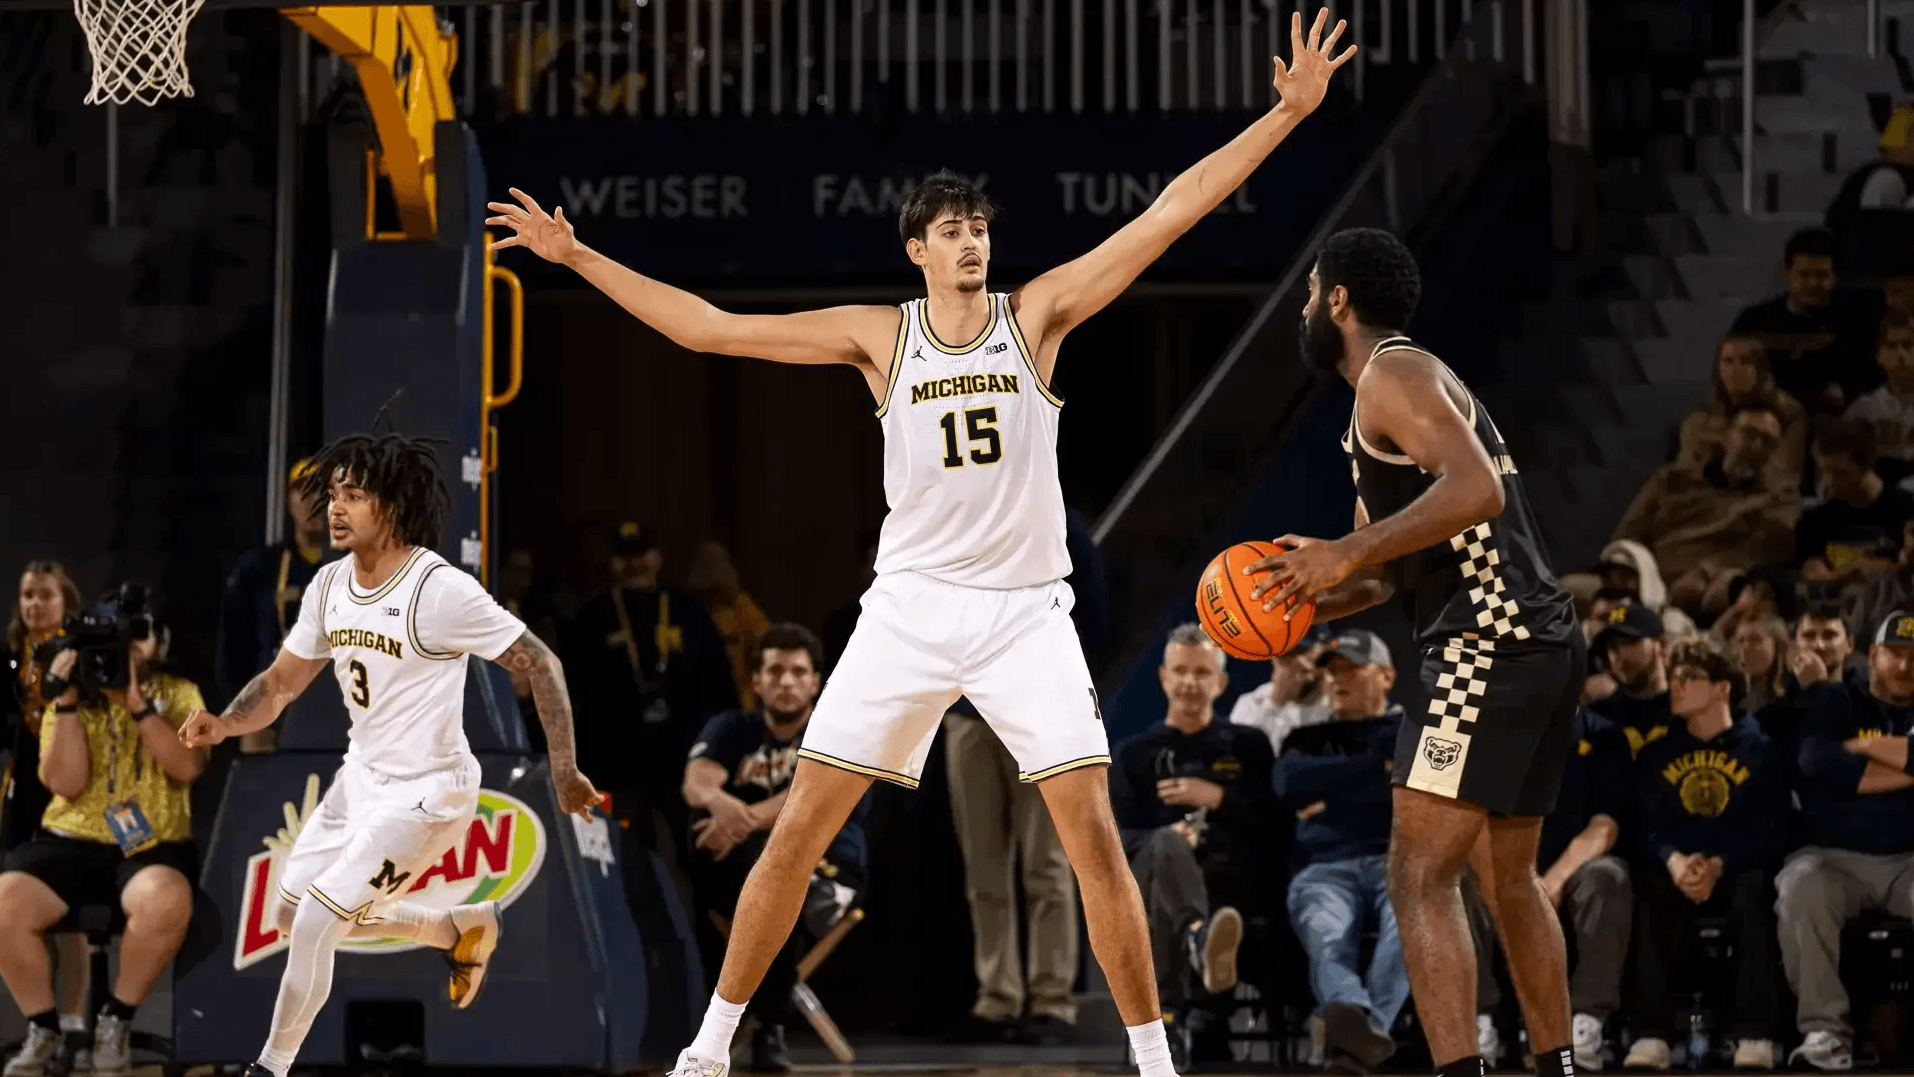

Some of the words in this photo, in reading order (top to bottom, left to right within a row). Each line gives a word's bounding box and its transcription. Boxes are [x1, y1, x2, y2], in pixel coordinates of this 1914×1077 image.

[559, 174, 748, 219] WEISER
[1054, 171, 1258, 216] TUNL
[910, 374, 1020, 405] MICHIGAN
[939, 405, 1002, 469] 15
[1206, 580, 1241, 640] ELITE
[349, 657, 371, 710] 3
[1662, 750, 1750, 786] MICHIGAN
[368, 859, 411, 895] M
